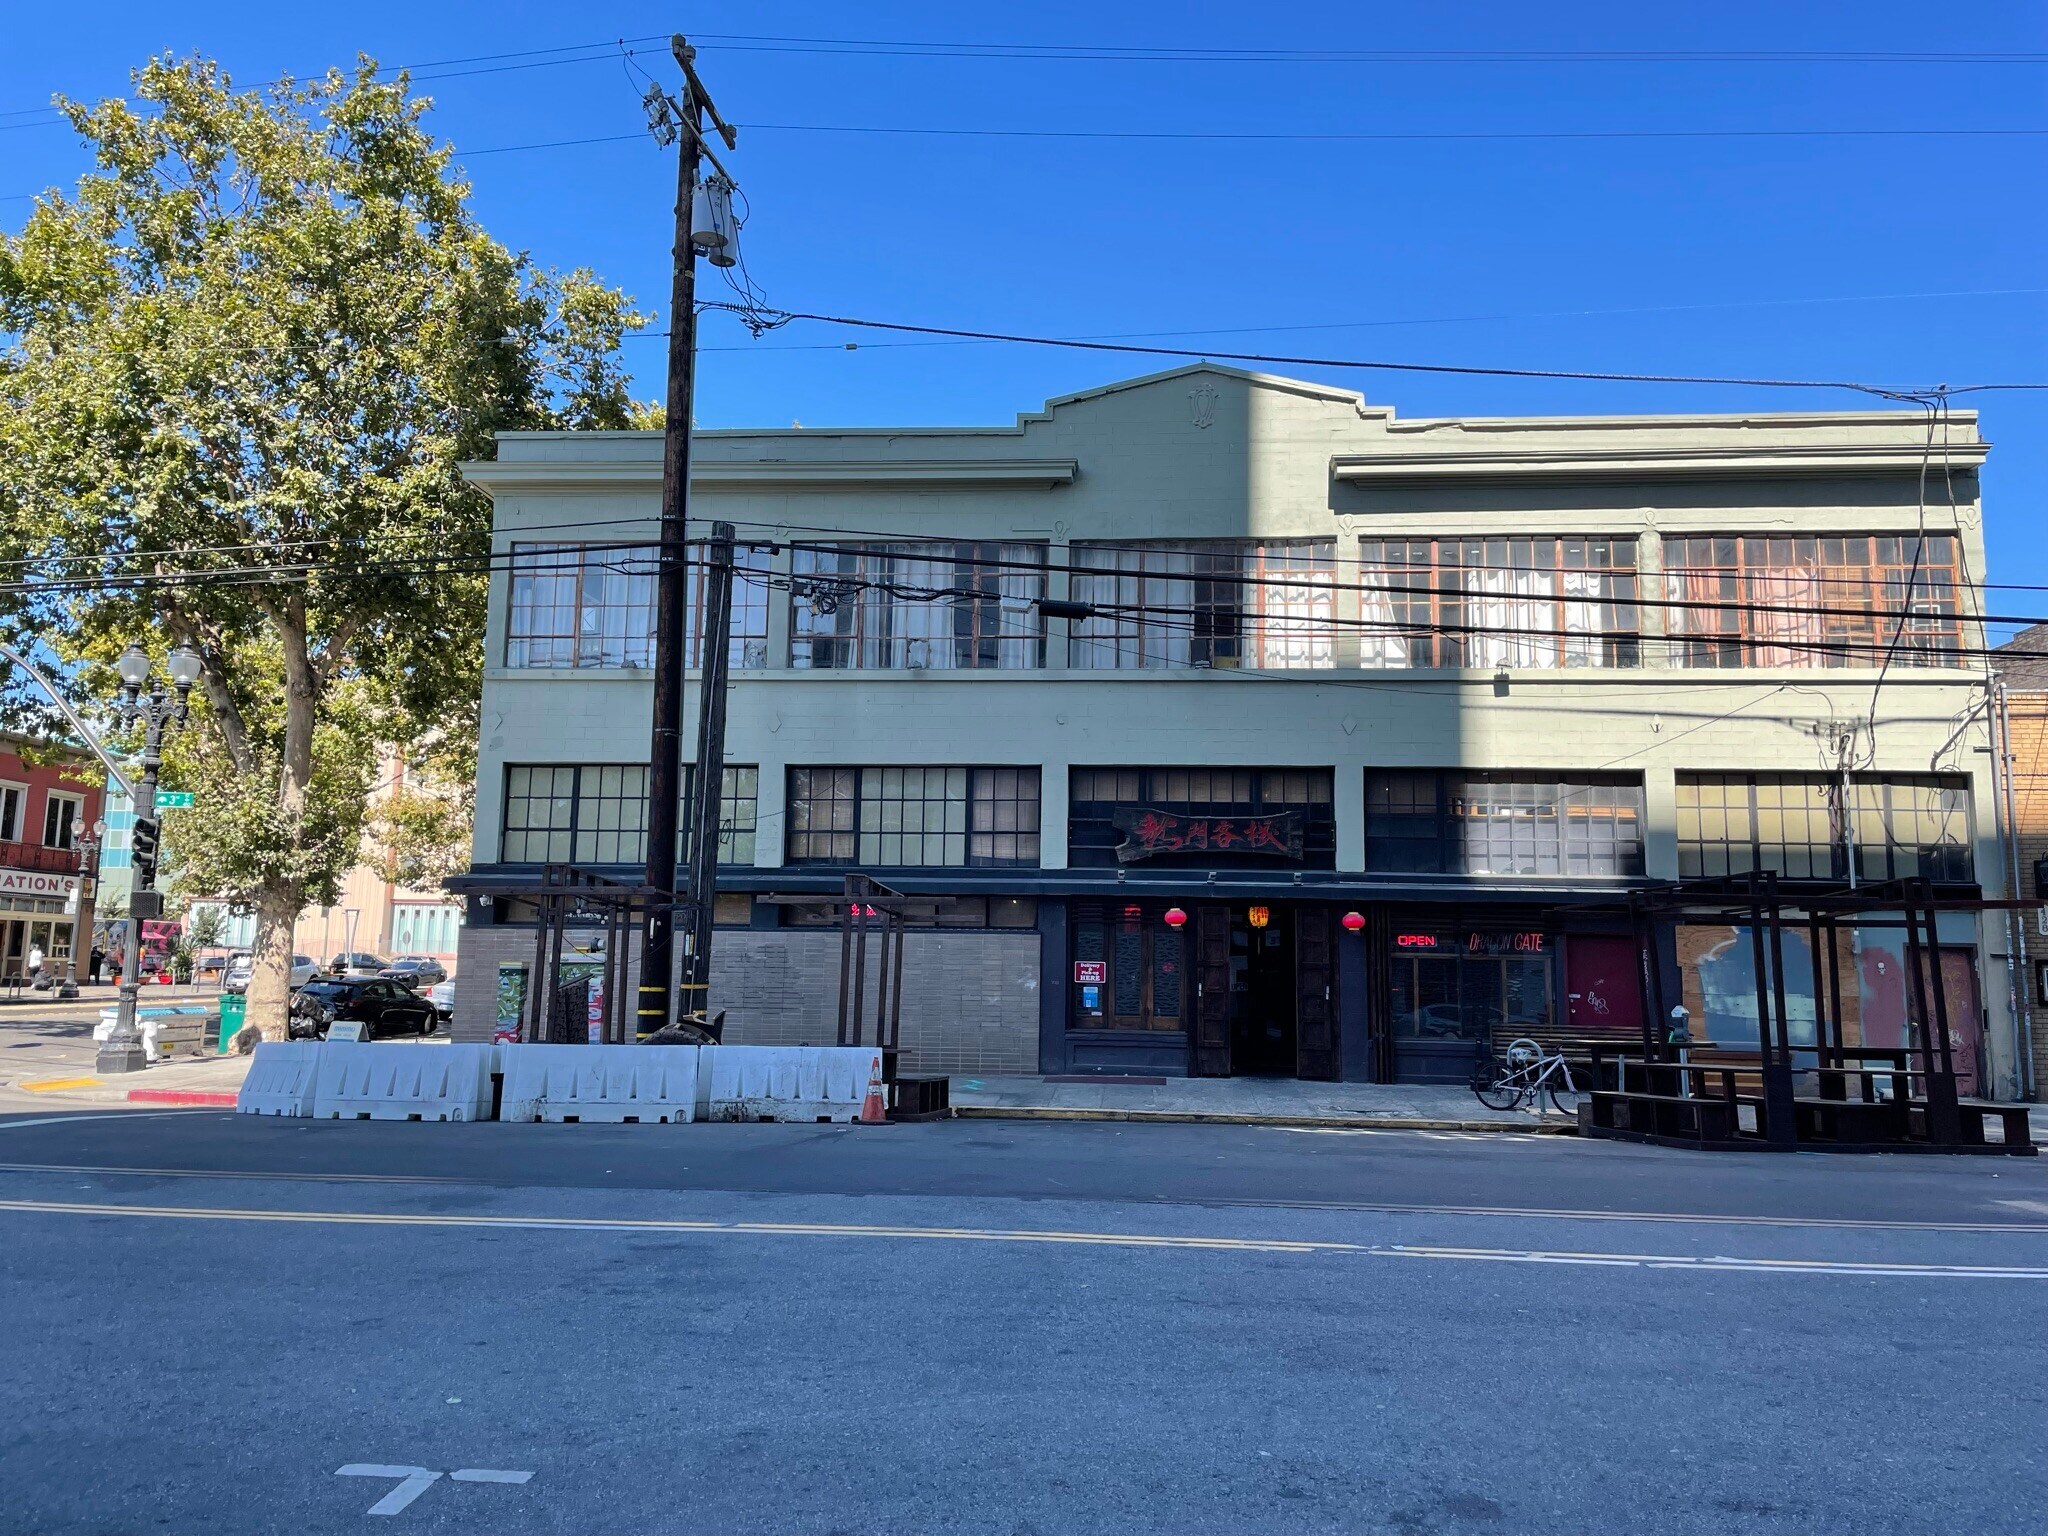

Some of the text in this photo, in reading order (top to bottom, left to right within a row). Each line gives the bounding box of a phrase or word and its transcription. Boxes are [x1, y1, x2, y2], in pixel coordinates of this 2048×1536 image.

[0, 873, 74, 893] ATION'S
[1397, 935, 1436, 946] OPEN
[1514, 932, 1545, 952] GATE
[1080, 974, 1101, 982] HERE
